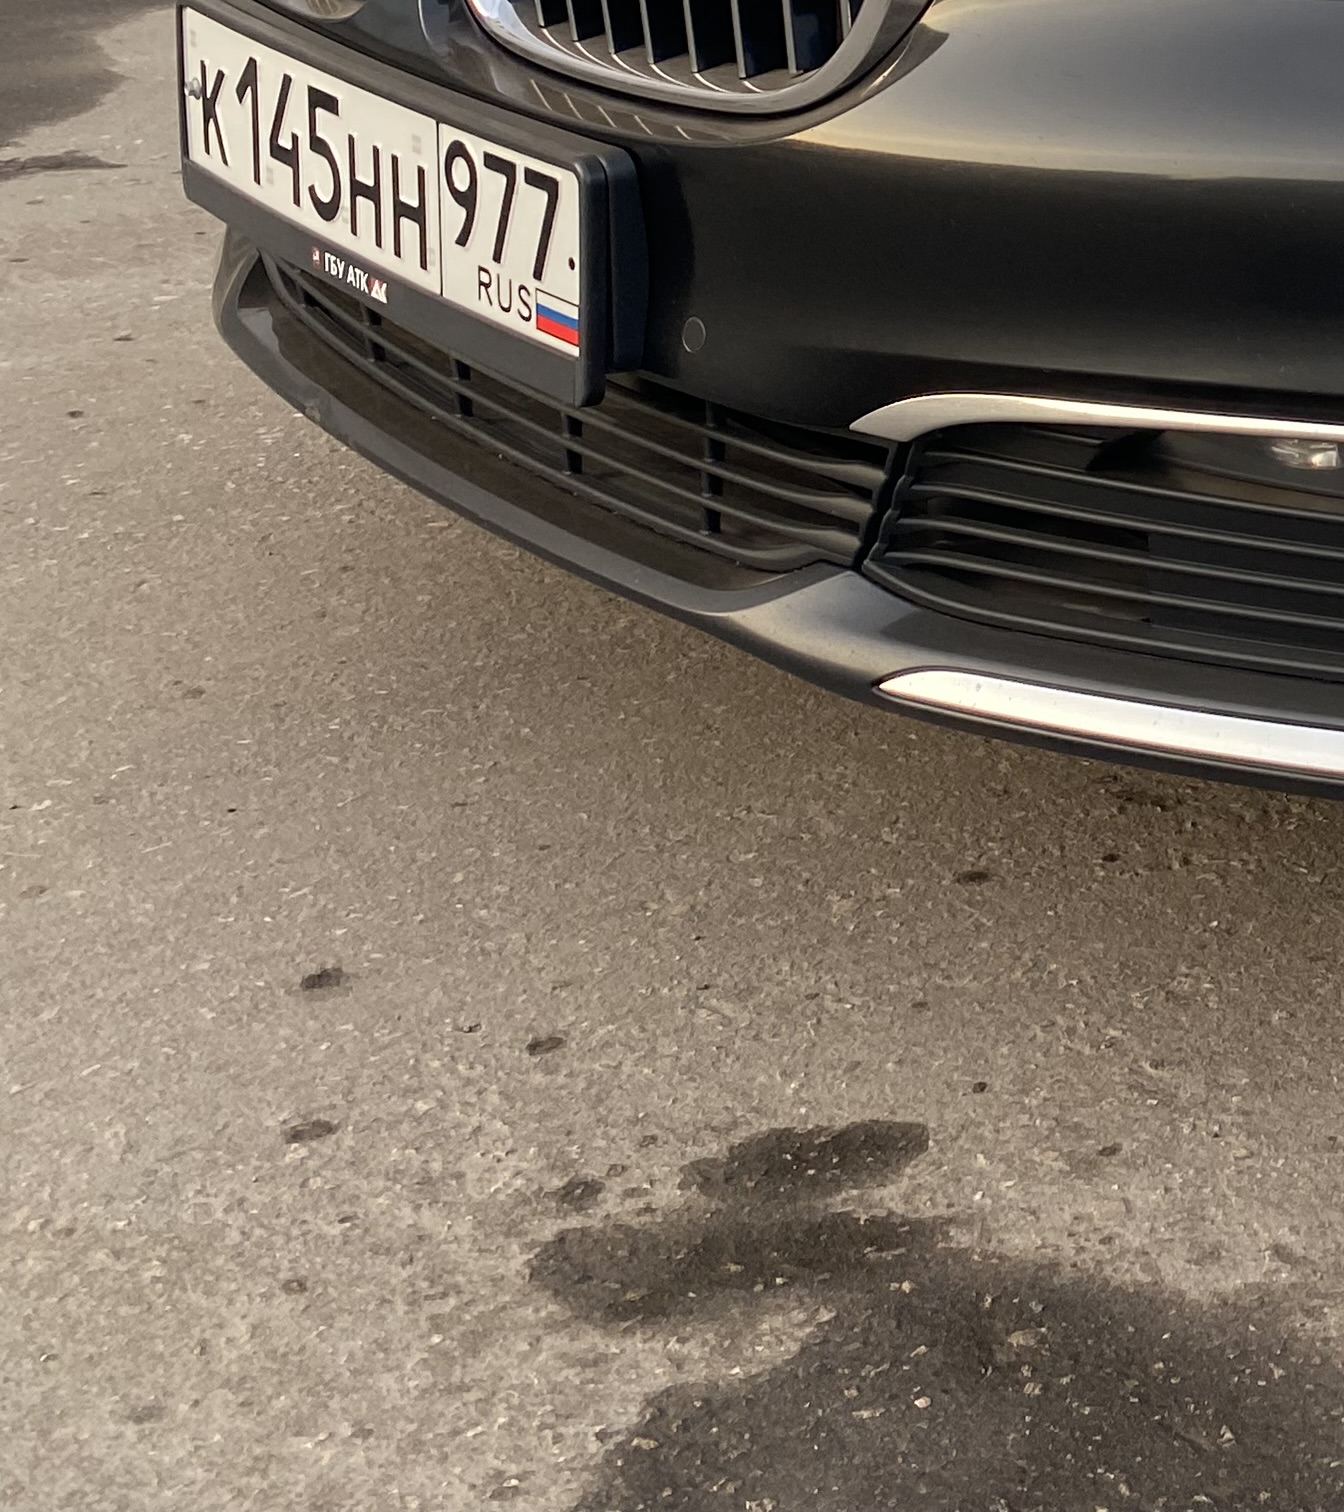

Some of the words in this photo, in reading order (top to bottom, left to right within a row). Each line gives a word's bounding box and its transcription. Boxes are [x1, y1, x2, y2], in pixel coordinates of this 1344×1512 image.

[199, 55, 429, 272] К145НН
[444, 139, 560, 282] 977
[324, 251, 345, 280] ГБУ
[346, 264, 369, 295] АТК
[477, 264, 533, 323] RUS
